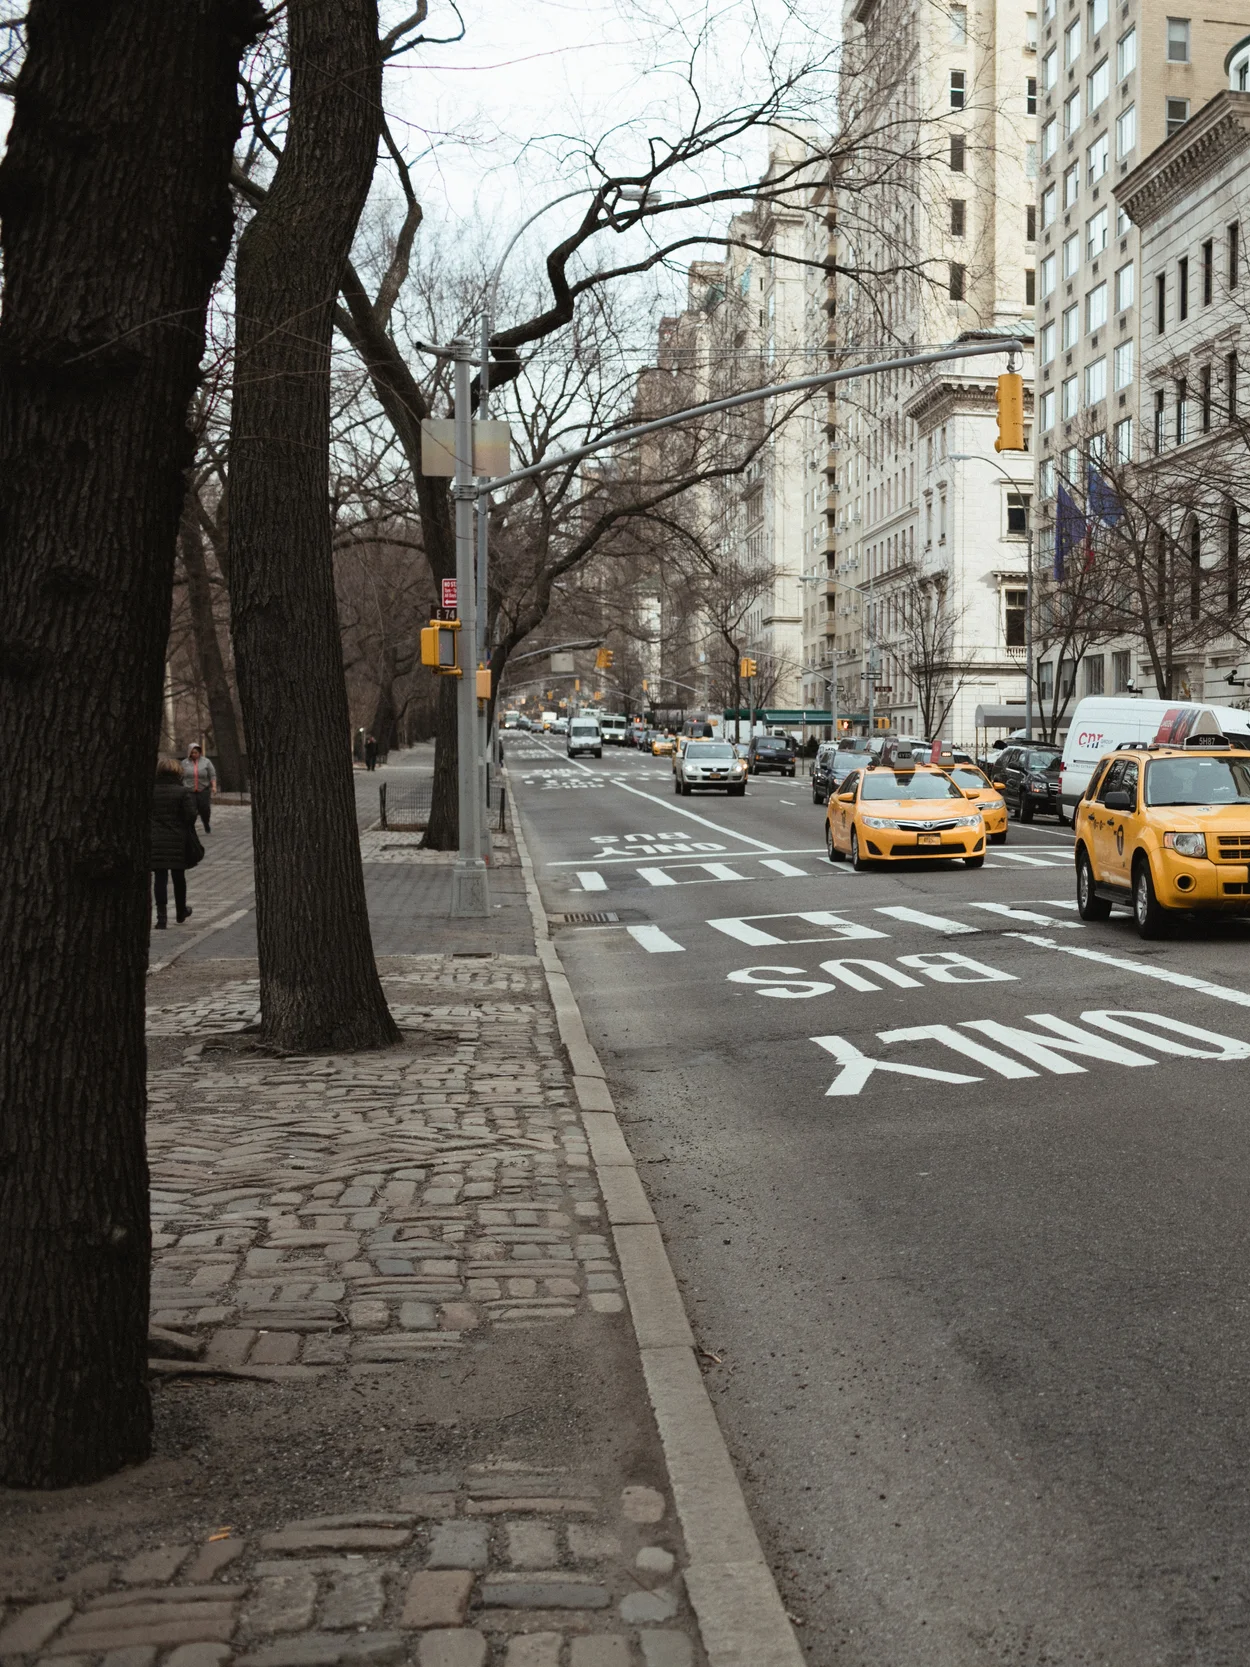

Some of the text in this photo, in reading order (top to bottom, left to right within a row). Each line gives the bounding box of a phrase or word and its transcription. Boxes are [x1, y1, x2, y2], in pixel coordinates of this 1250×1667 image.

[437, 610, 455, 619] E 74
[1199, 736, 1216, 746] 5H87
[590, 832, 692, 844] BUS
[593, 842, 727, 858] ONLY
[726, 952, 1021, 998] BUS
